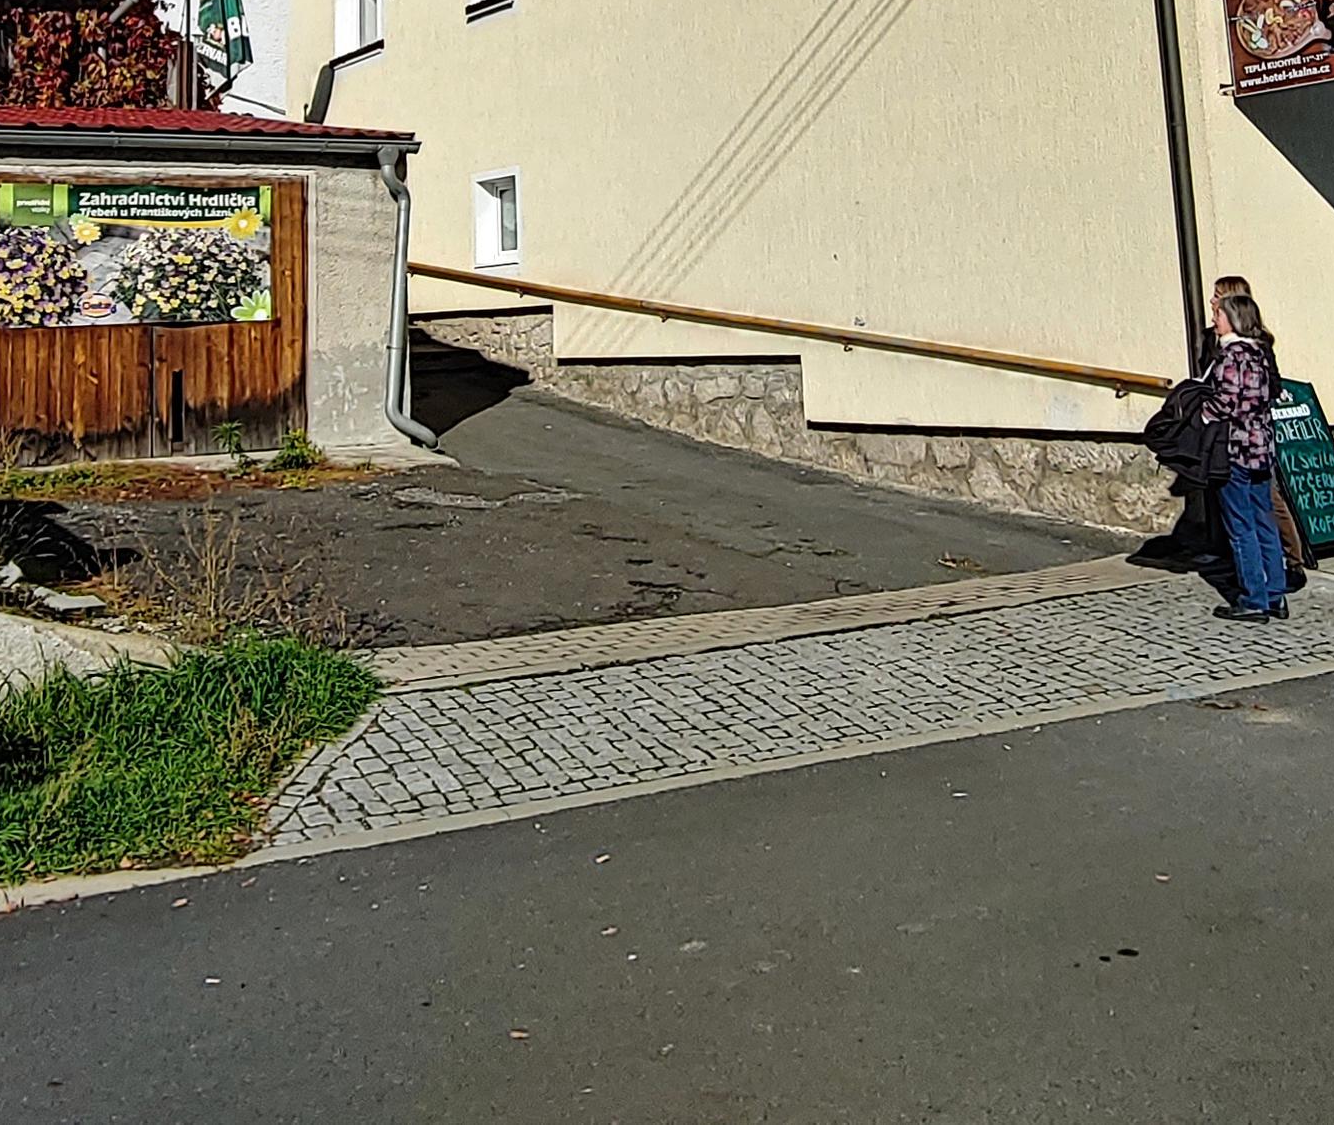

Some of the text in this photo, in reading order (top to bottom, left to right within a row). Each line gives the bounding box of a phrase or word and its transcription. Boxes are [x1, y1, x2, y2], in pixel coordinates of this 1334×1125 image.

[1239, 64, 1331, 89] www.hotel-skalna.cz
[78, 191, 256, 208] Zahradnictví Hrdlička
[120, 209, 128, 217] u
[1270, 403, 1311, 421] BERNARD
